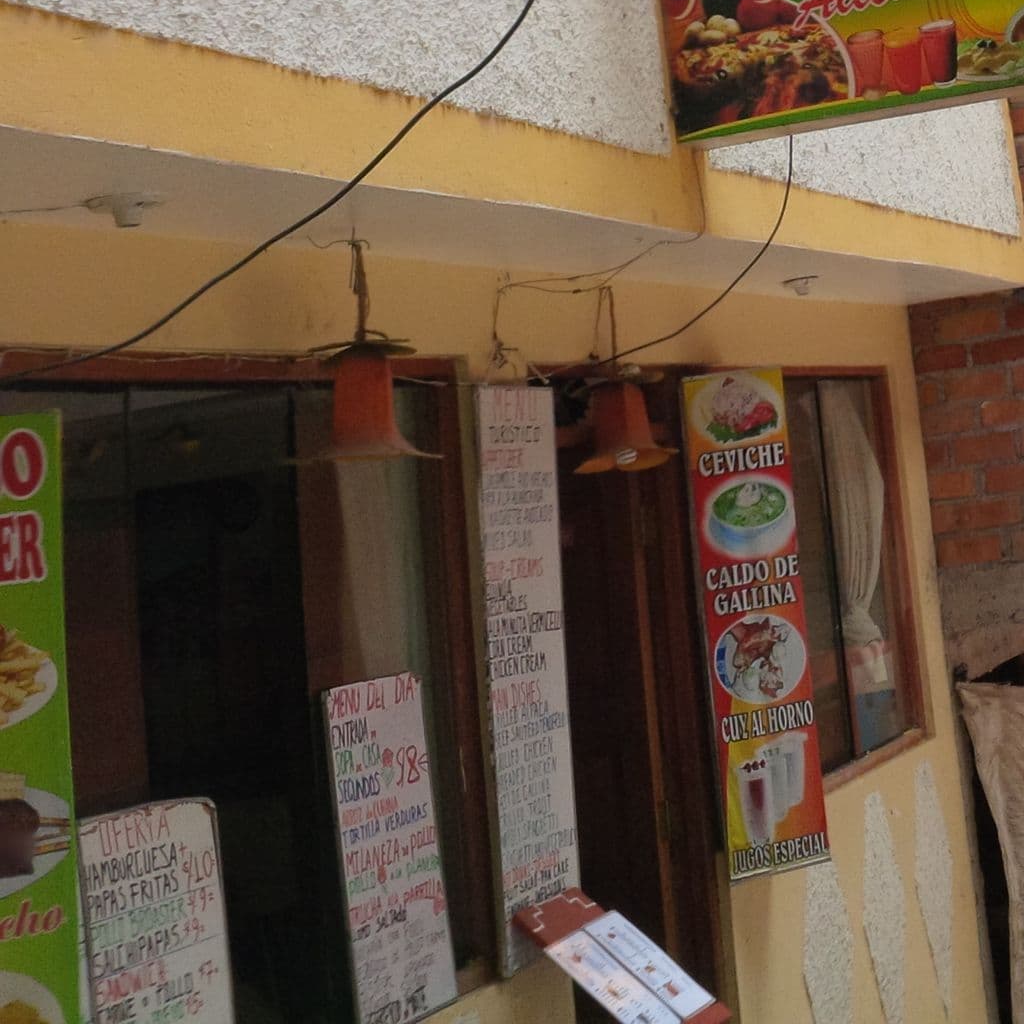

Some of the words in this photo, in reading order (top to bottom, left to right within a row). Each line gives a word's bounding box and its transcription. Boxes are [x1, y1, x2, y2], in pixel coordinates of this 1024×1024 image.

[699, 442, 785, 477] CEVICHE
[706, 560, 769, 591] CALDO
[774, 554, 800, 578] DE
[714, 582, 797, 616] GALLINA
[331, 688, 360, 720] MENU
[367, 682, 385, 711] DEL
[395, 674, 416, 705] DIA
[332, 717, 368, 750] ENTRADA
[721, 712, 749, 744] CUY
[752, 710, 766, 738] AL
[767, 700, 814, 733] HORNO
[99, 813, 170, 857] OFERTA
[342, 820, 381, 848] TORTILLA
[385, 802, 428, 833] VERDURAS
[345, 839, 400, 877] MILANEZA
[732, 843, 773, 875] JUGOS
[773, 831, 829, 865] ESPECIAL
[87, 885, 127, 922] PAPAS
[130, 868, 179, 907] FRITAS
